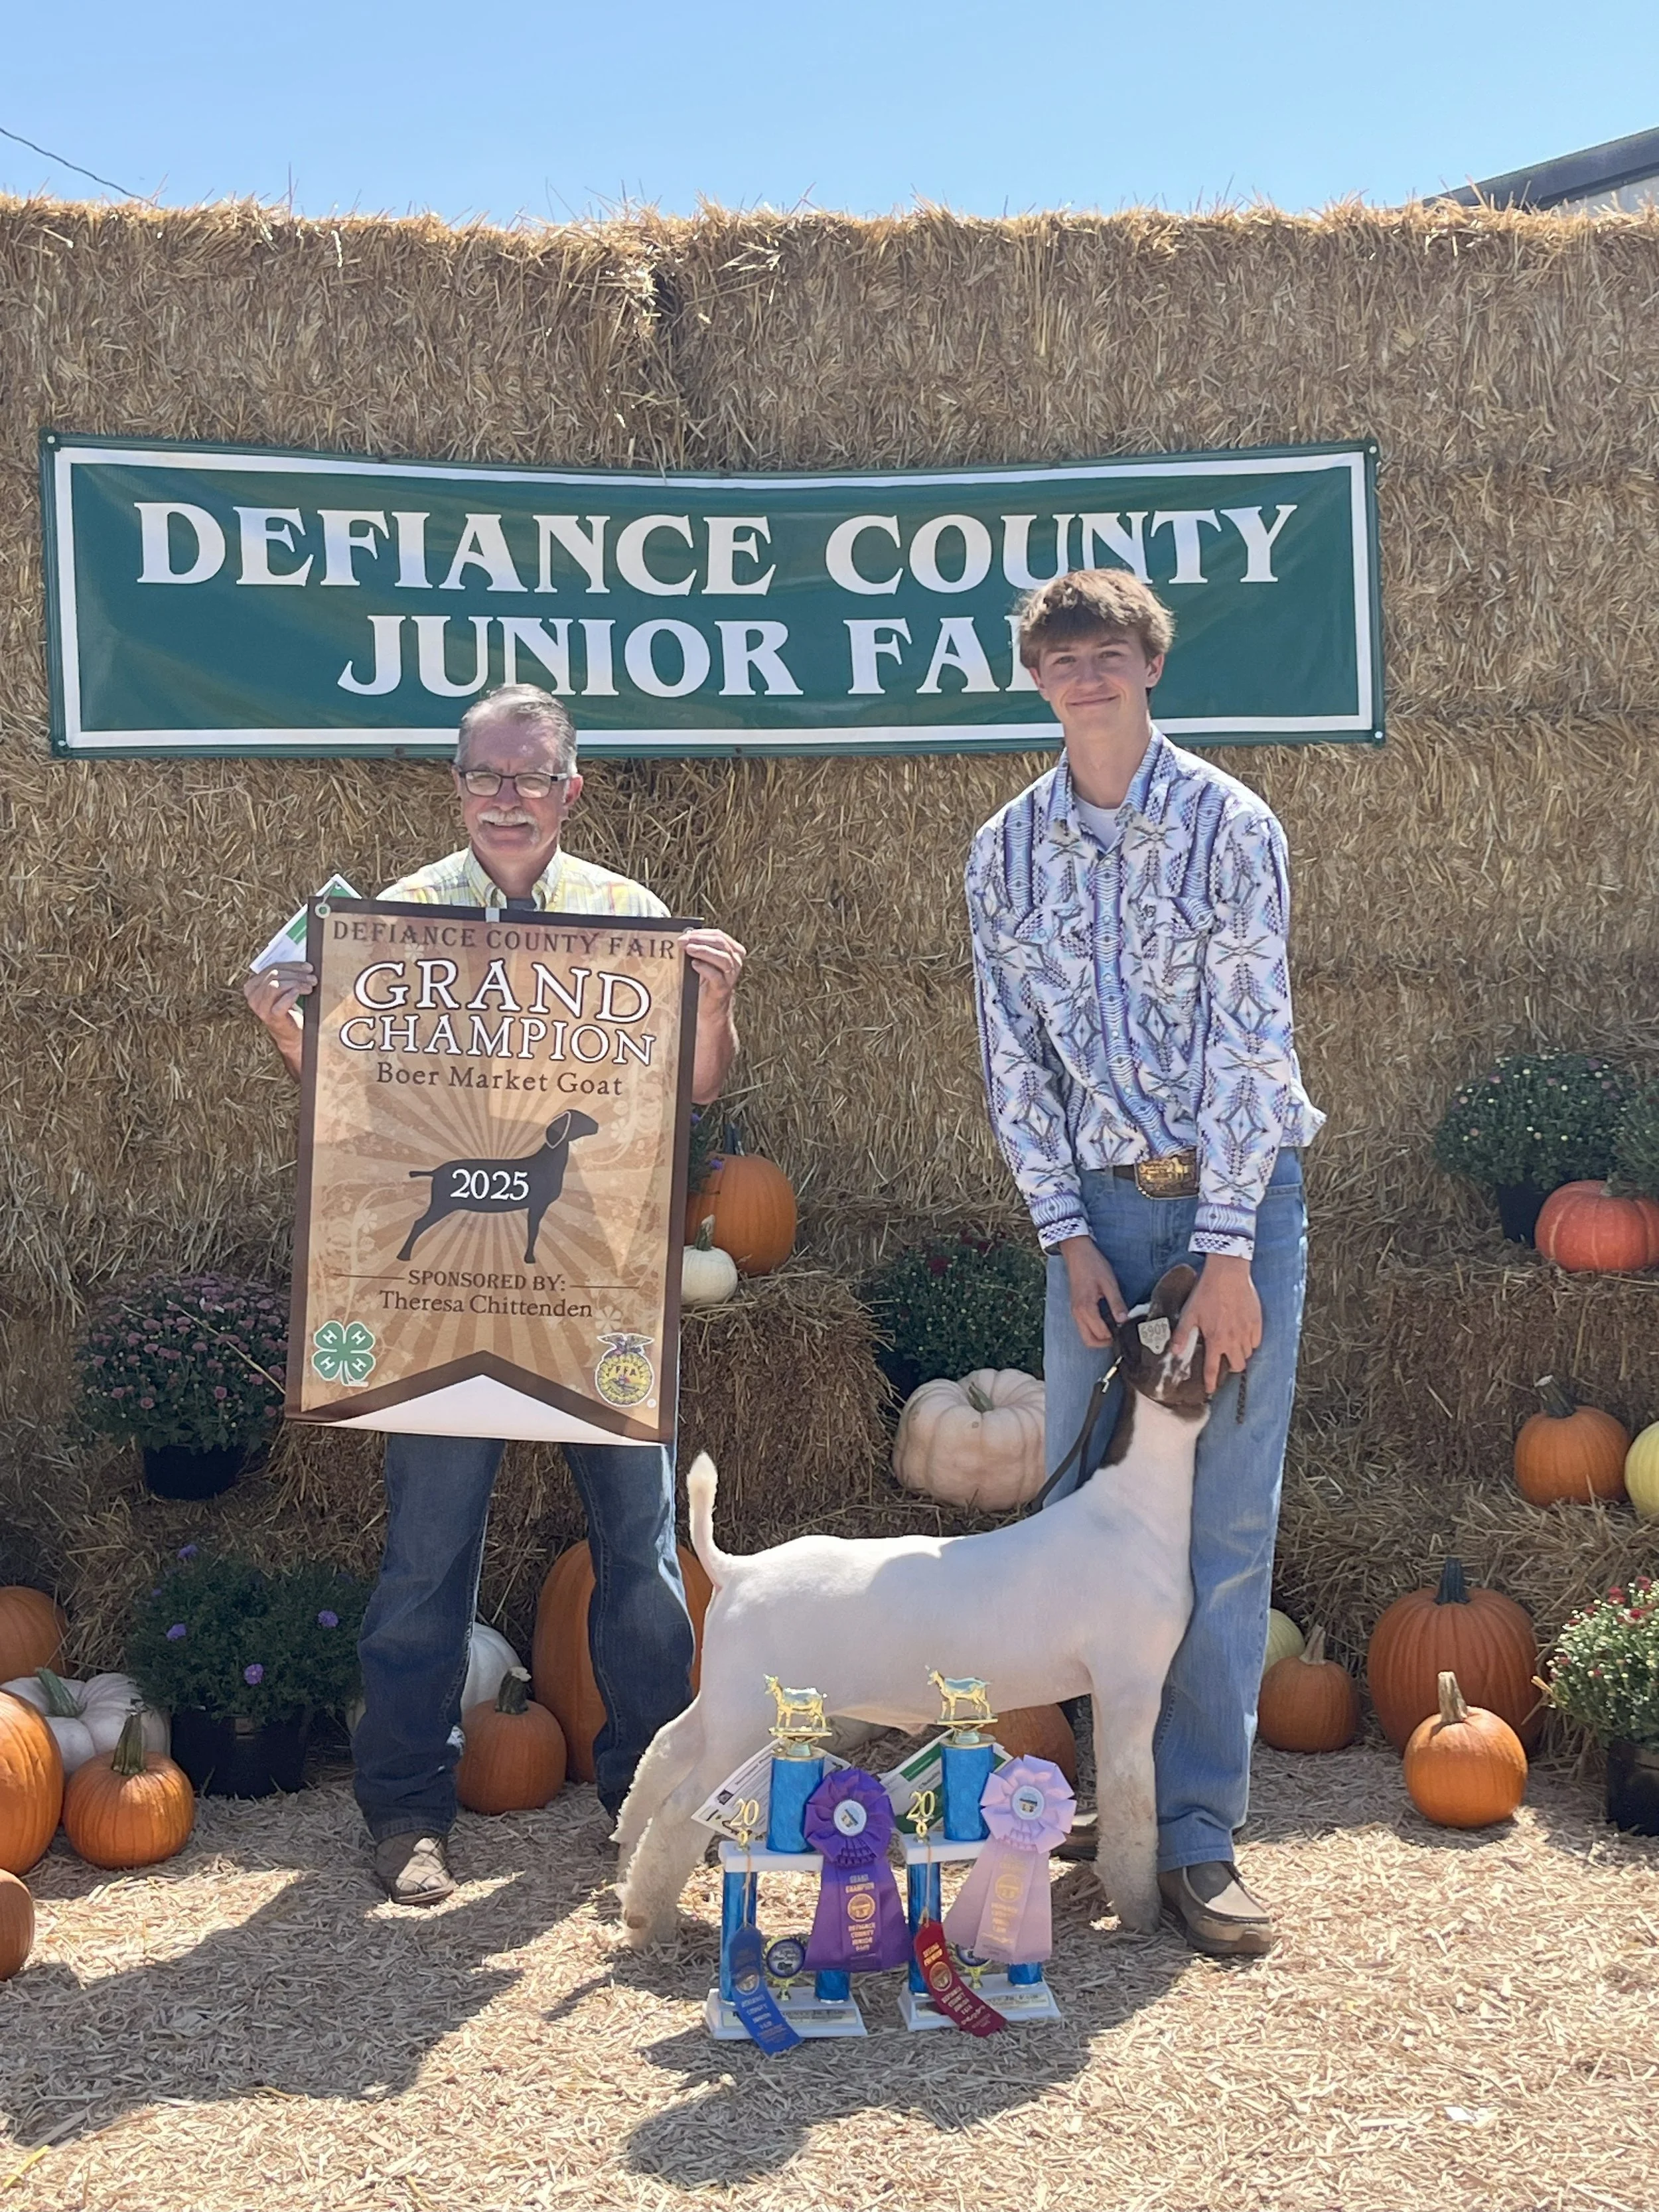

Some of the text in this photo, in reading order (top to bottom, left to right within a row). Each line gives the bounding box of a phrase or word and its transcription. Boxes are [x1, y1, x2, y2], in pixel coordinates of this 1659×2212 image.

[133, 502, 1298, 596] DEFIANCE COUNTY
[336, 615, 804, 698] JUNIOR
[334, 921, 676, 960] DEFIANCE COUNTY FAIR
[353, 958, 652, 1024] GRAND
[339, 1013, 656, 1067] CHAMPION
[377, 1062, 622, 1096] Boer Market Goat
[450, 1168, 530, 1201] 2025
[408, 1270, 566, 1292] SPONSORED BY:
[379, 1290, 593, 1317] Theresa Chittenden
[616, 1366, 636, 1376] FFA
